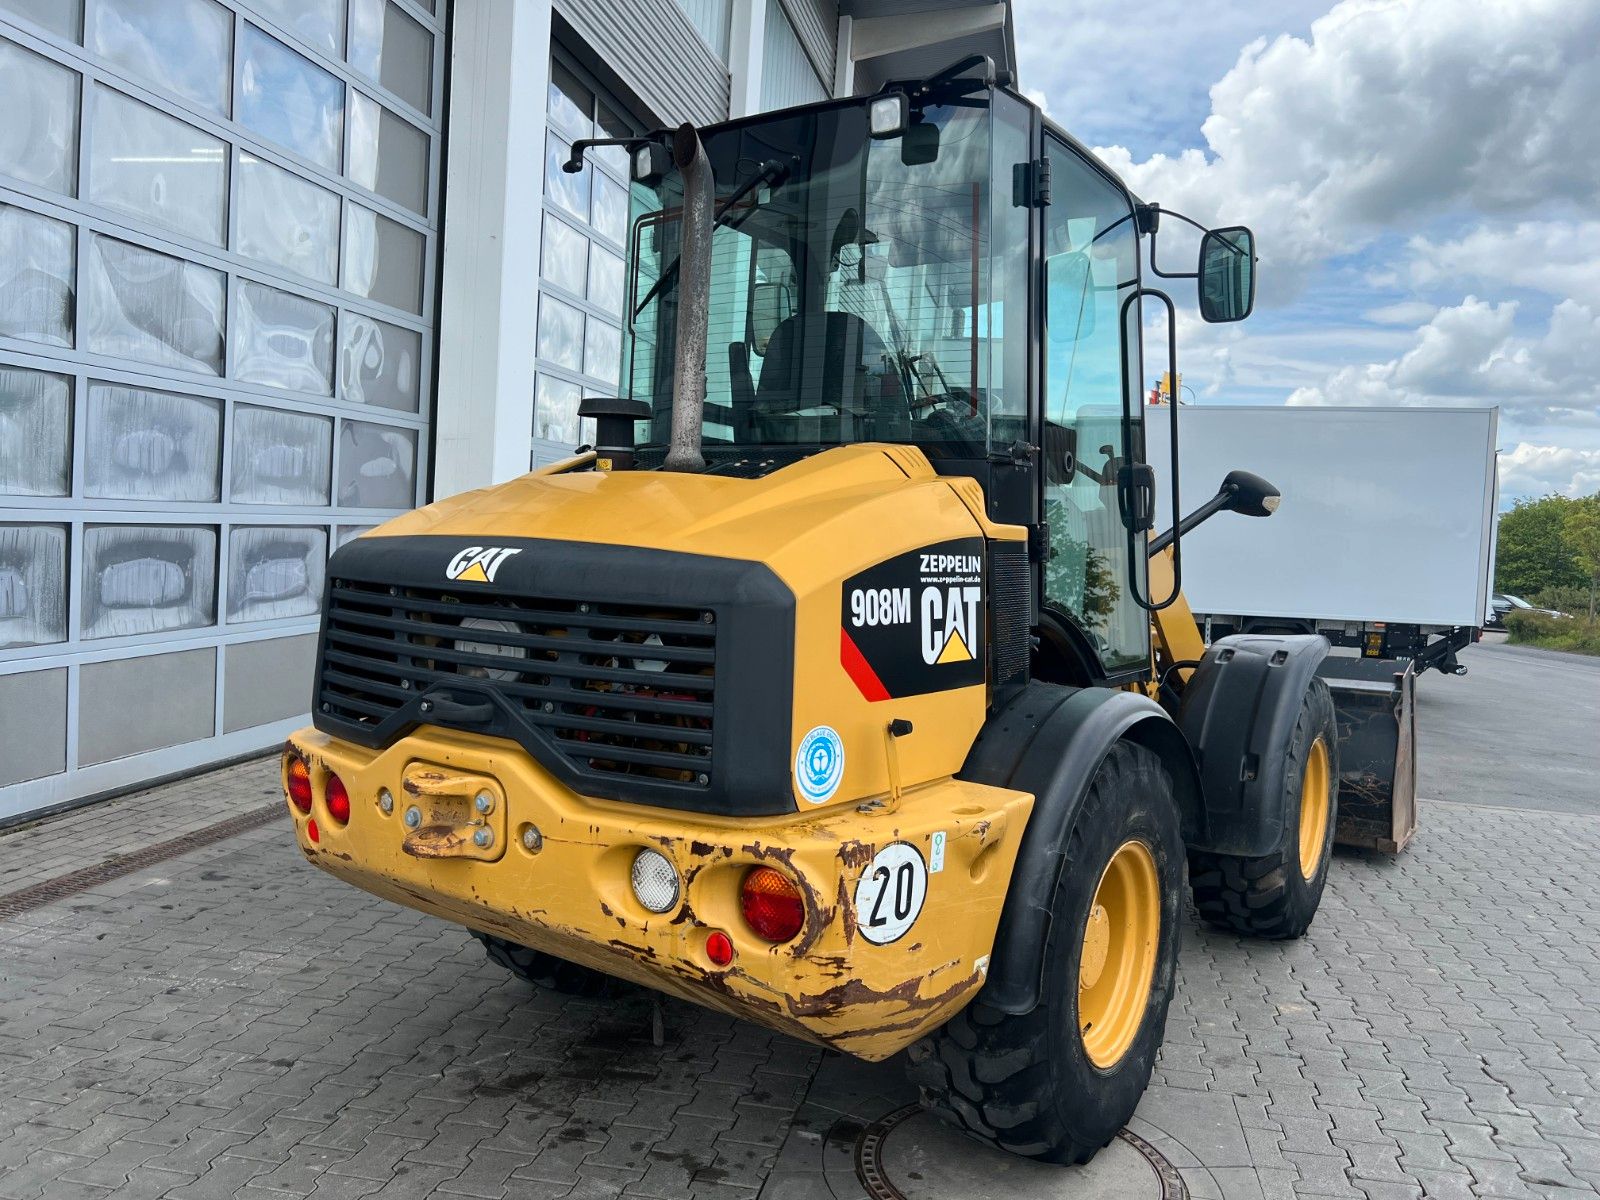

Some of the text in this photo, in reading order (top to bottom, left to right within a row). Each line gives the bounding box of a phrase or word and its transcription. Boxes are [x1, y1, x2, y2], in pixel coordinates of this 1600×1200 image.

[446, 546, 522, 582] CAT
[920, 554, 981, 573] ZEPPELIN
[920, 575, 981, 583] www.zeppelin-cat.de
[851, 587, 911, 627] 908M
[921, 586, 981, 665] CAT
[869, 862, 914, 926] 20
